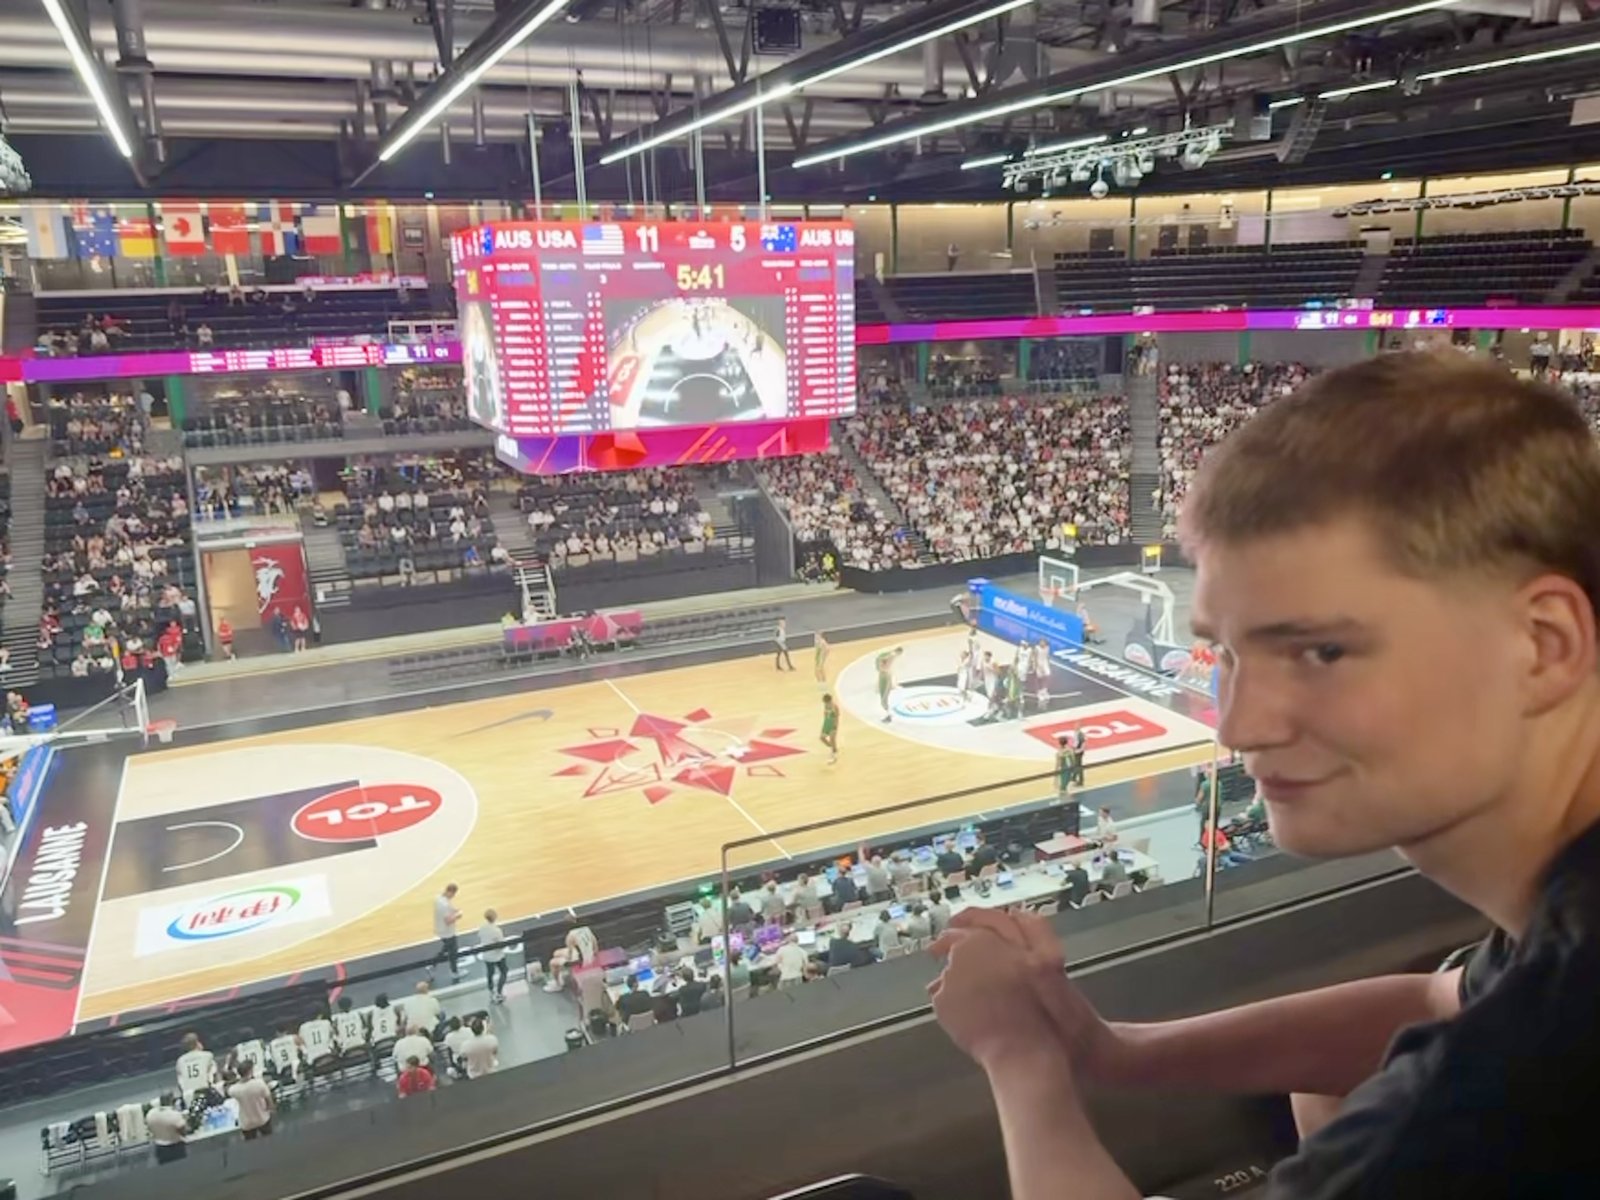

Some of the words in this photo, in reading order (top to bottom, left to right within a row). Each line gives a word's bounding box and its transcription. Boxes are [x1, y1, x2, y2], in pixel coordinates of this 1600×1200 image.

[494, 230, 533, 248] AUS
[537, 230, 577, 248] USA
[636, 225, 659, 252] 11
[730, 225, 745, 252] 5
[800, 229, 832, 246] AUS
[676, 264, 725, 290] 5:41
[1052, 648, 1182, 697] LAUSANNE
[306, 795, 433, 825] TCL
[13, 821, 88, 926] LAUSANNE
[311, 1030, 323, 1045] 11
[344, 1023, 357, 1038] 12
[281, 1049, 289, 1061] 9
[186, 1063, 200, 1079] 15
[1213, 1170, 1251, 1192] 220
